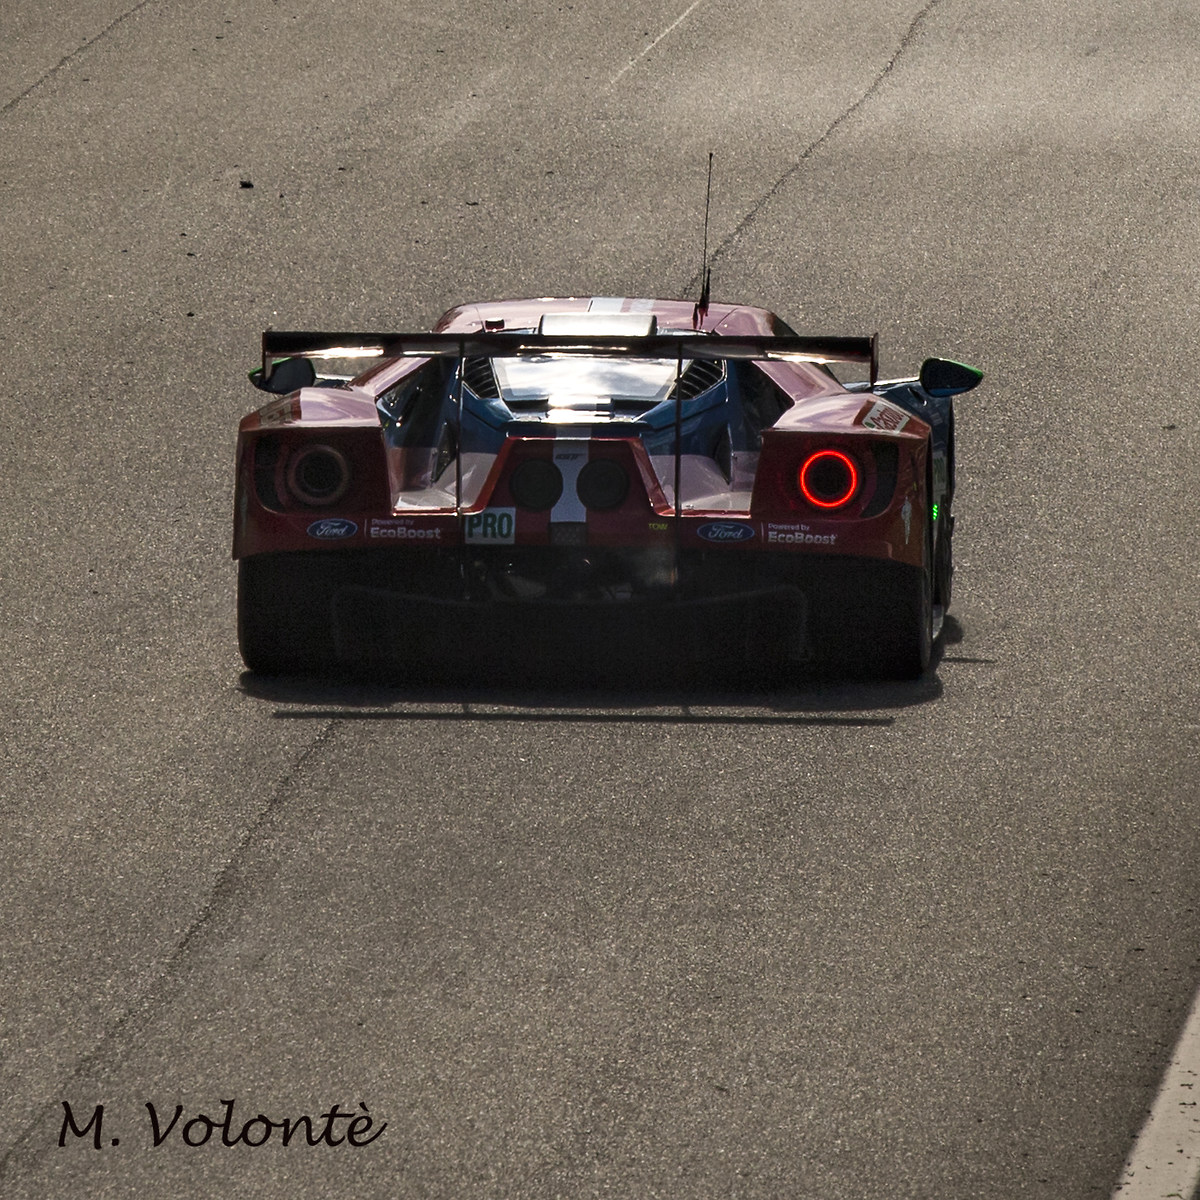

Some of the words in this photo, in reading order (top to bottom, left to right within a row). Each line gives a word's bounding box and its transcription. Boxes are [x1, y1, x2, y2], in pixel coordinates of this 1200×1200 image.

[315, 520, 349, 536] Ford
[371, 518, 403, 526] Powered
[404, 518, 415, 528] by
[467, 512, 514, 539] PRO
[648, 522, 668, 531] TOW
[768, 522, 799, 531] Powered
[800, 523, 810, 532] by
[370, 526, 441, 539] EcoBoost
[707, 524, 744, 540] Ford
[768, 531, 837, 545] EcoBoost
